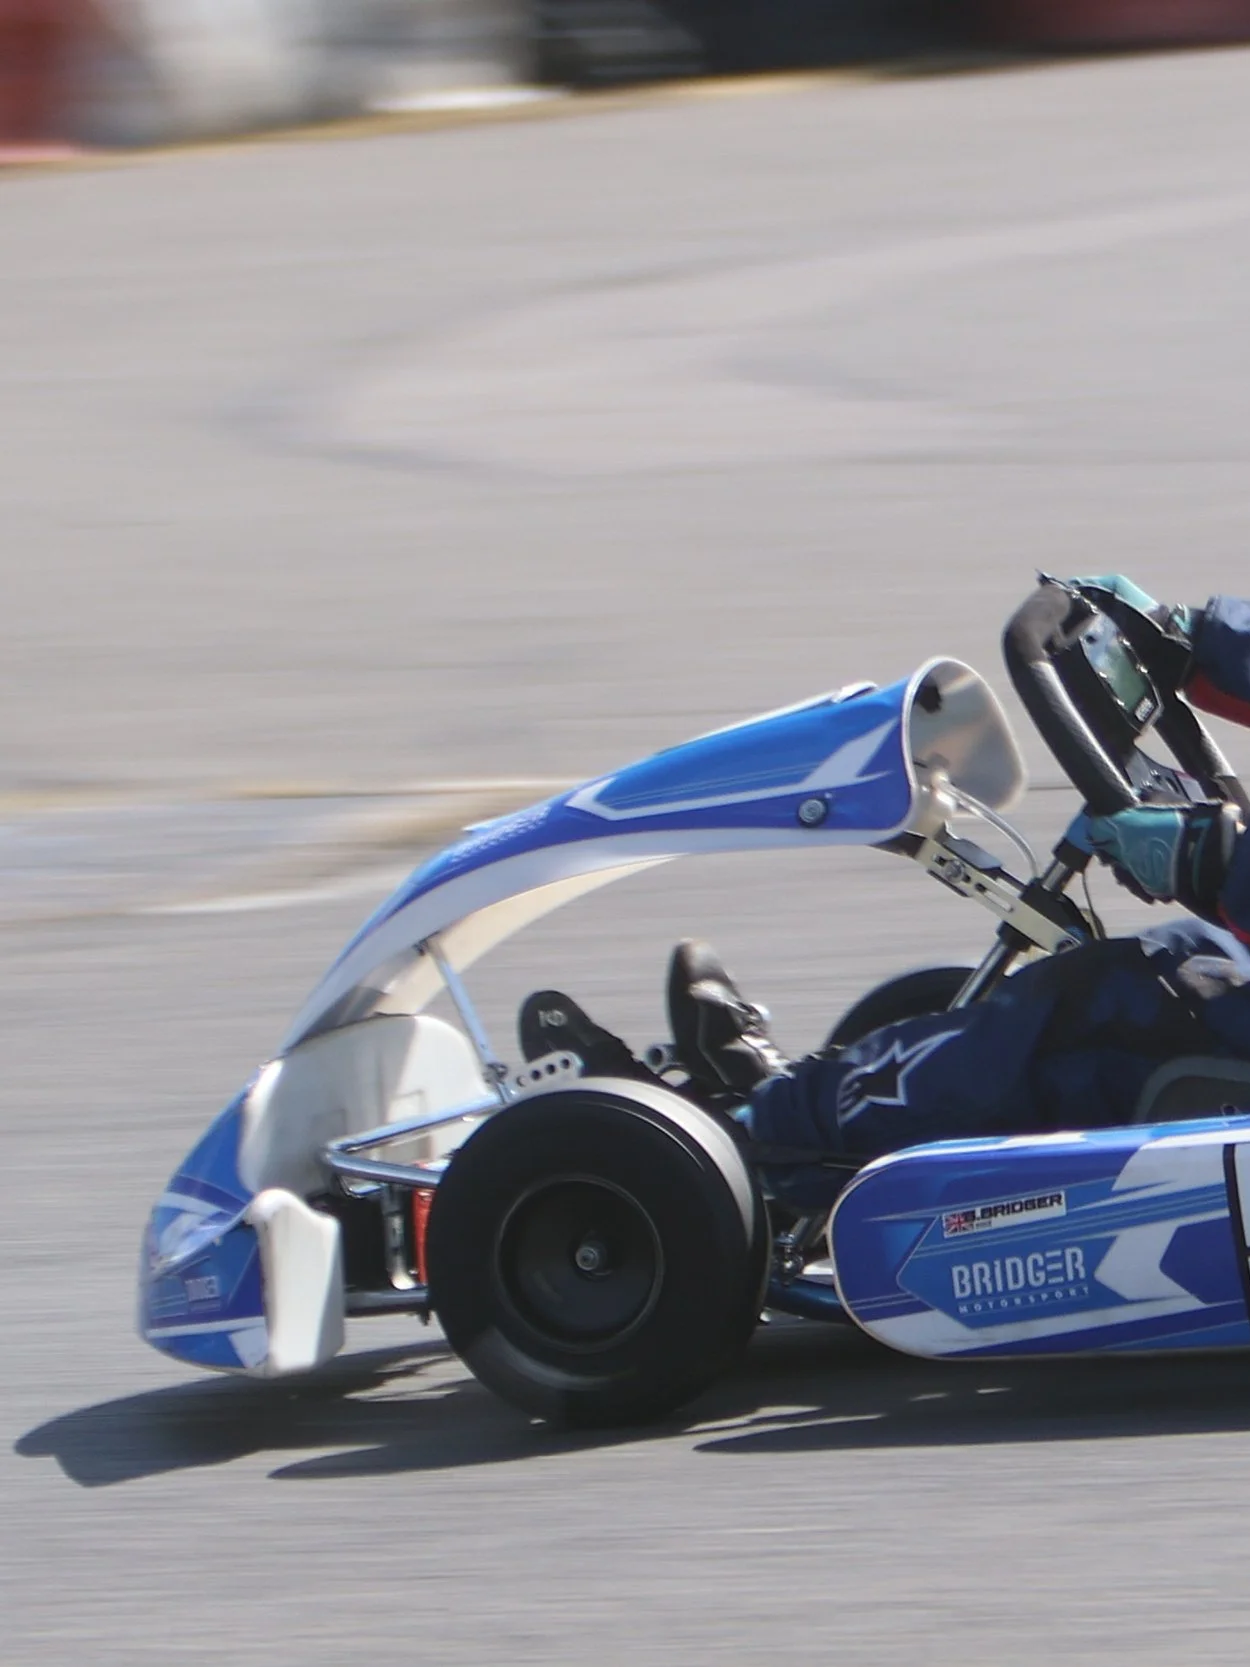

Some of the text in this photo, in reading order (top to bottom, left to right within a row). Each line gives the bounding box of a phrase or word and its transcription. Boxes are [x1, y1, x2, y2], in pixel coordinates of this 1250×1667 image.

[963, 1193, 1063, 1222] B.BRIDGER
[951, 1246, 1086, 1299] BRIDGER
[958, 1286, 1089, 1314] MOTORSPORT
